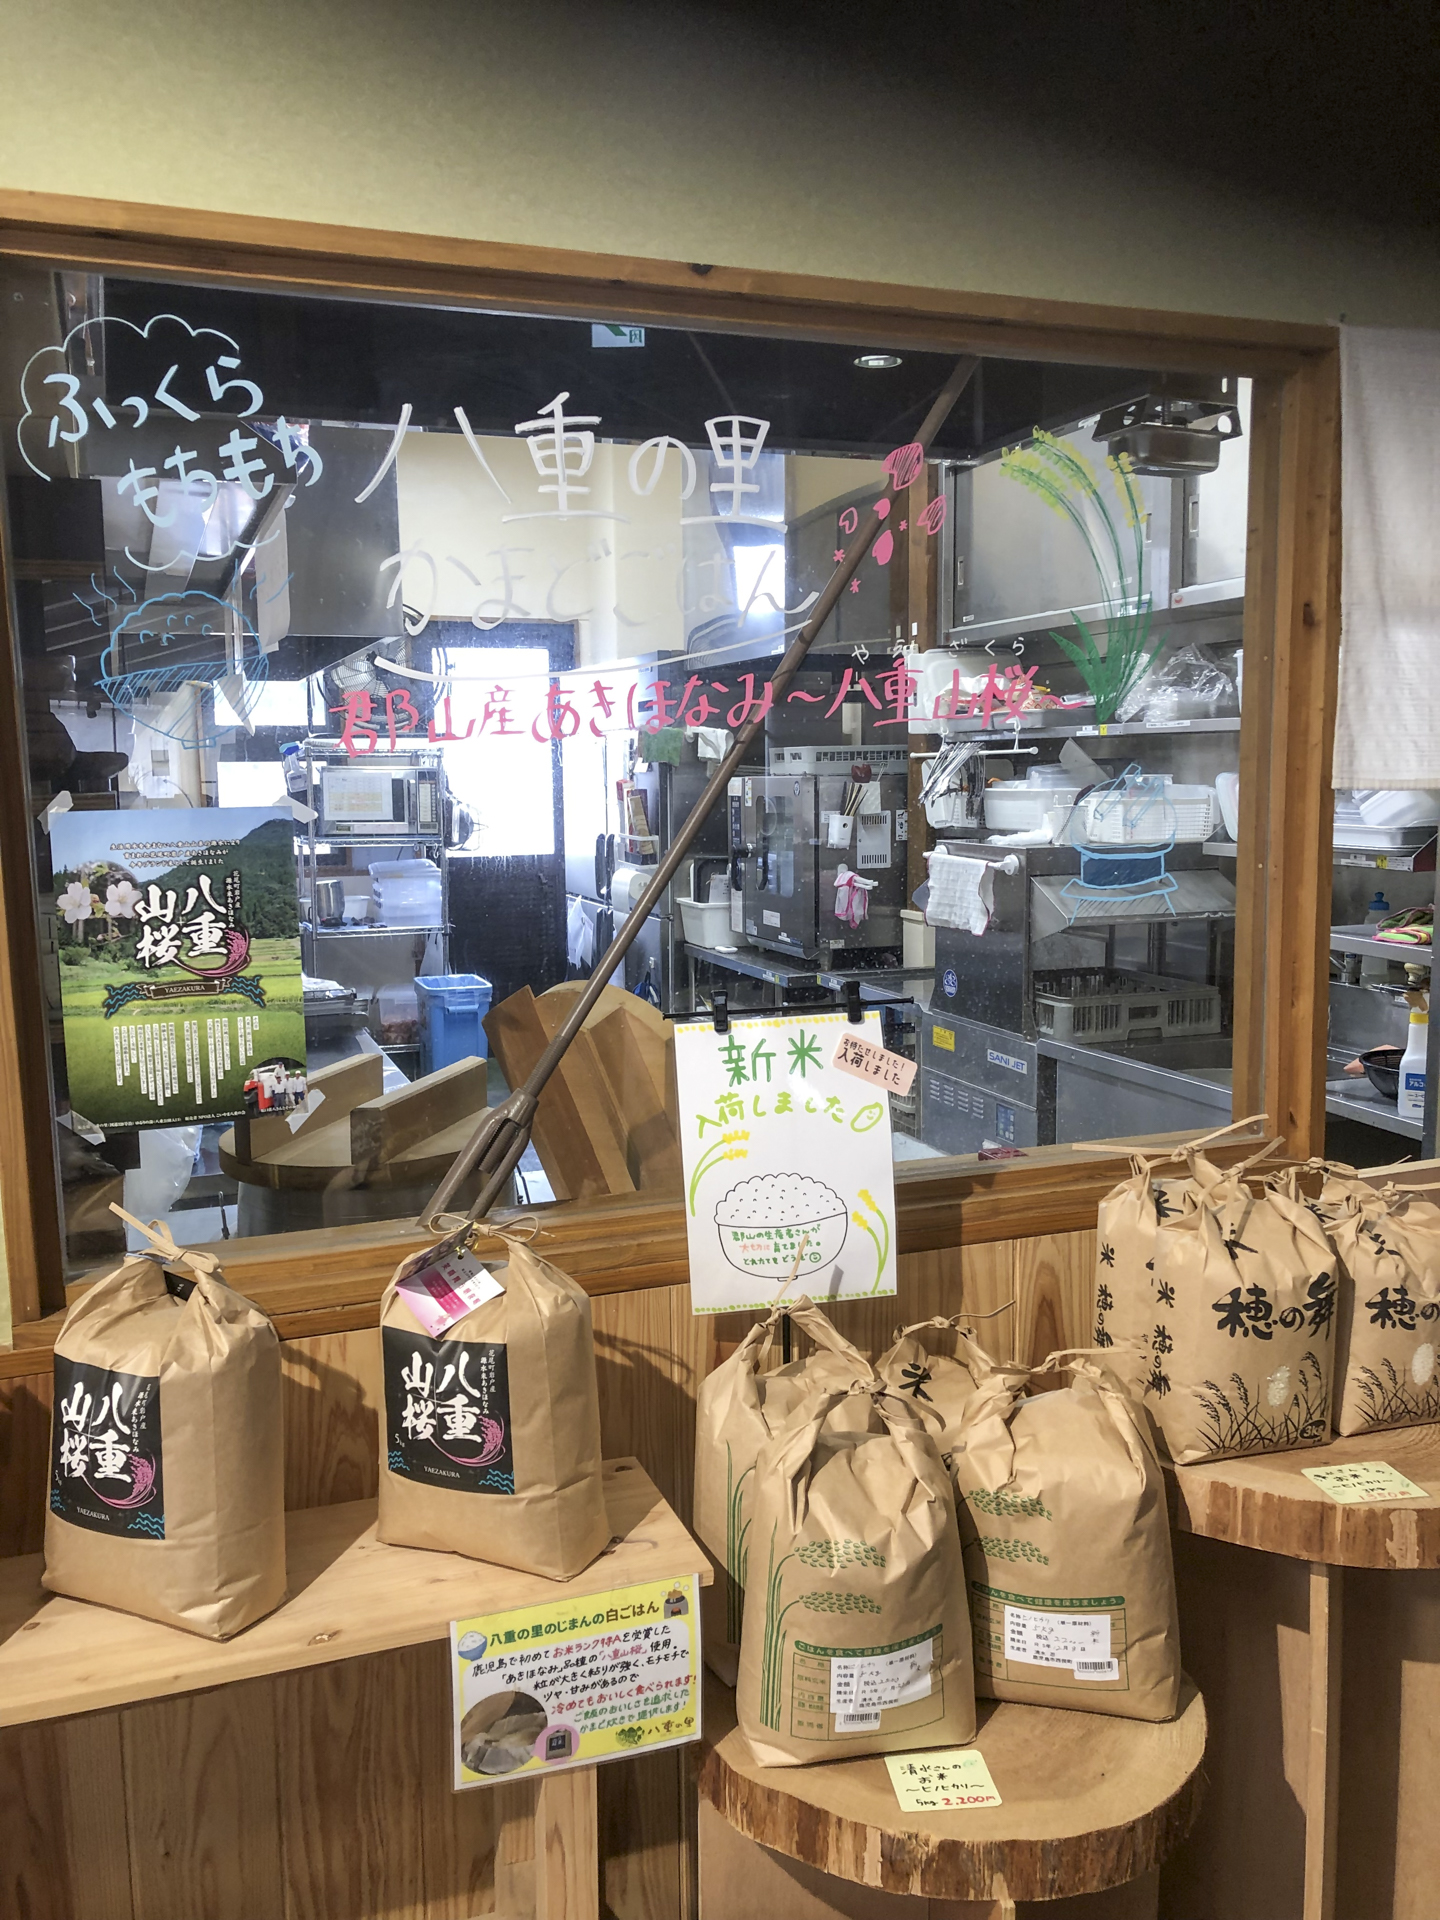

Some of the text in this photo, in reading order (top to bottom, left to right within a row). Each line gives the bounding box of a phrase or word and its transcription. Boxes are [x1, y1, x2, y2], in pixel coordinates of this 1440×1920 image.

[43, 356, 265, 448] ふっくら
[117, 415, 324, 528] もちもち
[355, 391, 788, 533] 八重の里
[380, 538, 821, 637] かまどごはん
[164, 985, 206, 994] YAEZAKURA
[717, 1028, 823, 1088] 新米
[837, 1047, 901, 1086] 入荷しました
[989, 1051, 1026, 1073] SANI JET
[695, 1091, 846, 1138] 入荷しました
[731, 1223, 821, 1242] 郡山の生産者さんが
[1100, 1242, 1116, 1268] 米
[1156, 1278, 1176, 1309] 米
[1212, 1271, 1337, 1341] 穂の舞
[423, 1465, 461, 1479] YAEZAKURA
[76, 1505, 110, 1521] YAEZAKURA
[490, 1601, 660, 1647] 八重の里のじまんの白ごはん
[918, 1773, 948, 1784] お米
